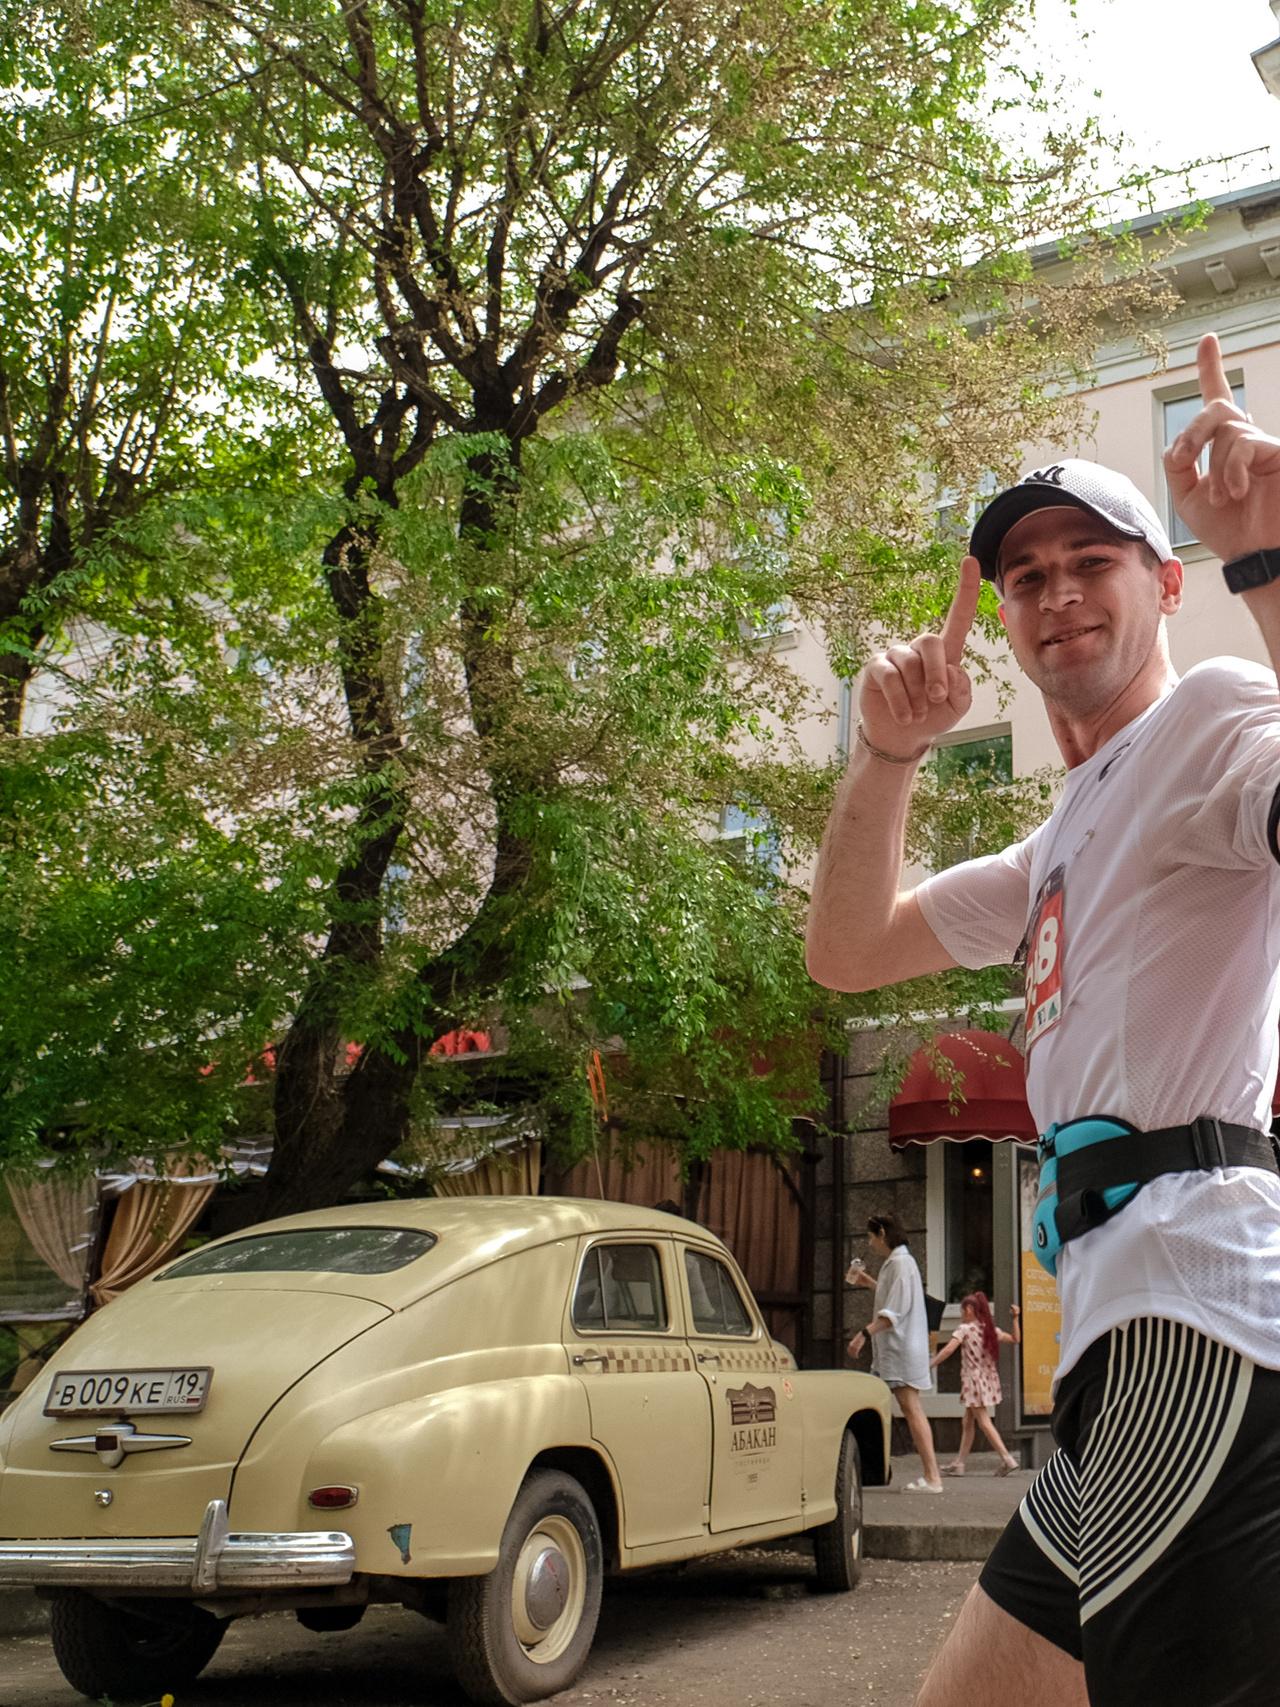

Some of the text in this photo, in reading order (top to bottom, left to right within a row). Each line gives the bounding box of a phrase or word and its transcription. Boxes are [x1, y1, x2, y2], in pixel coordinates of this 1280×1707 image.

[174, 1373, 199, 1395] 19
[166, 1395, 186, 1404] RUS
[731, 1426, 777, 1452] АБАКАН
